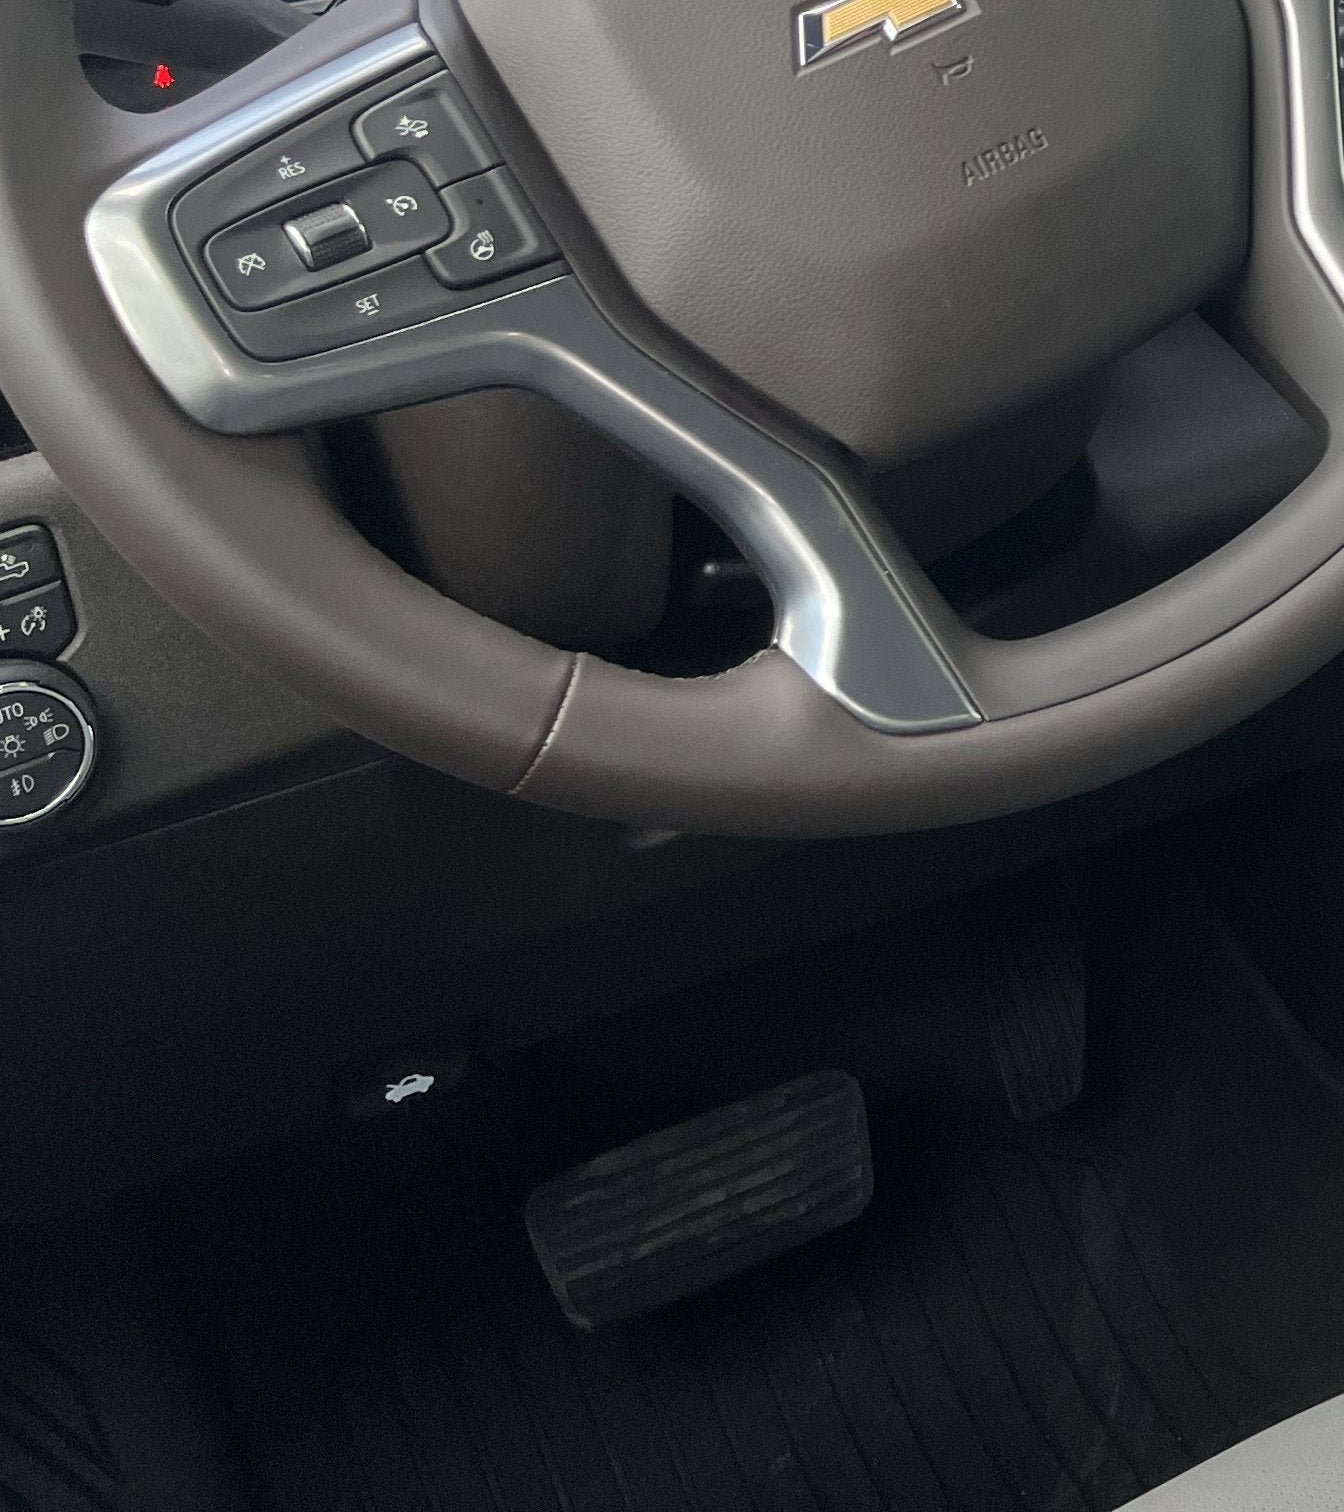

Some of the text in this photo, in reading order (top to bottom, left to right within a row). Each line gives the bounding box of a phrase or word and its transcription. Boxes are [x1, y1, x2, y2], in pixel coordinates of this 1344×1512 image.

[962, 126, 1049, 188] AIRBAG
[278, 161, 306, 180] RES
[355, 293, 380, 314] SET
